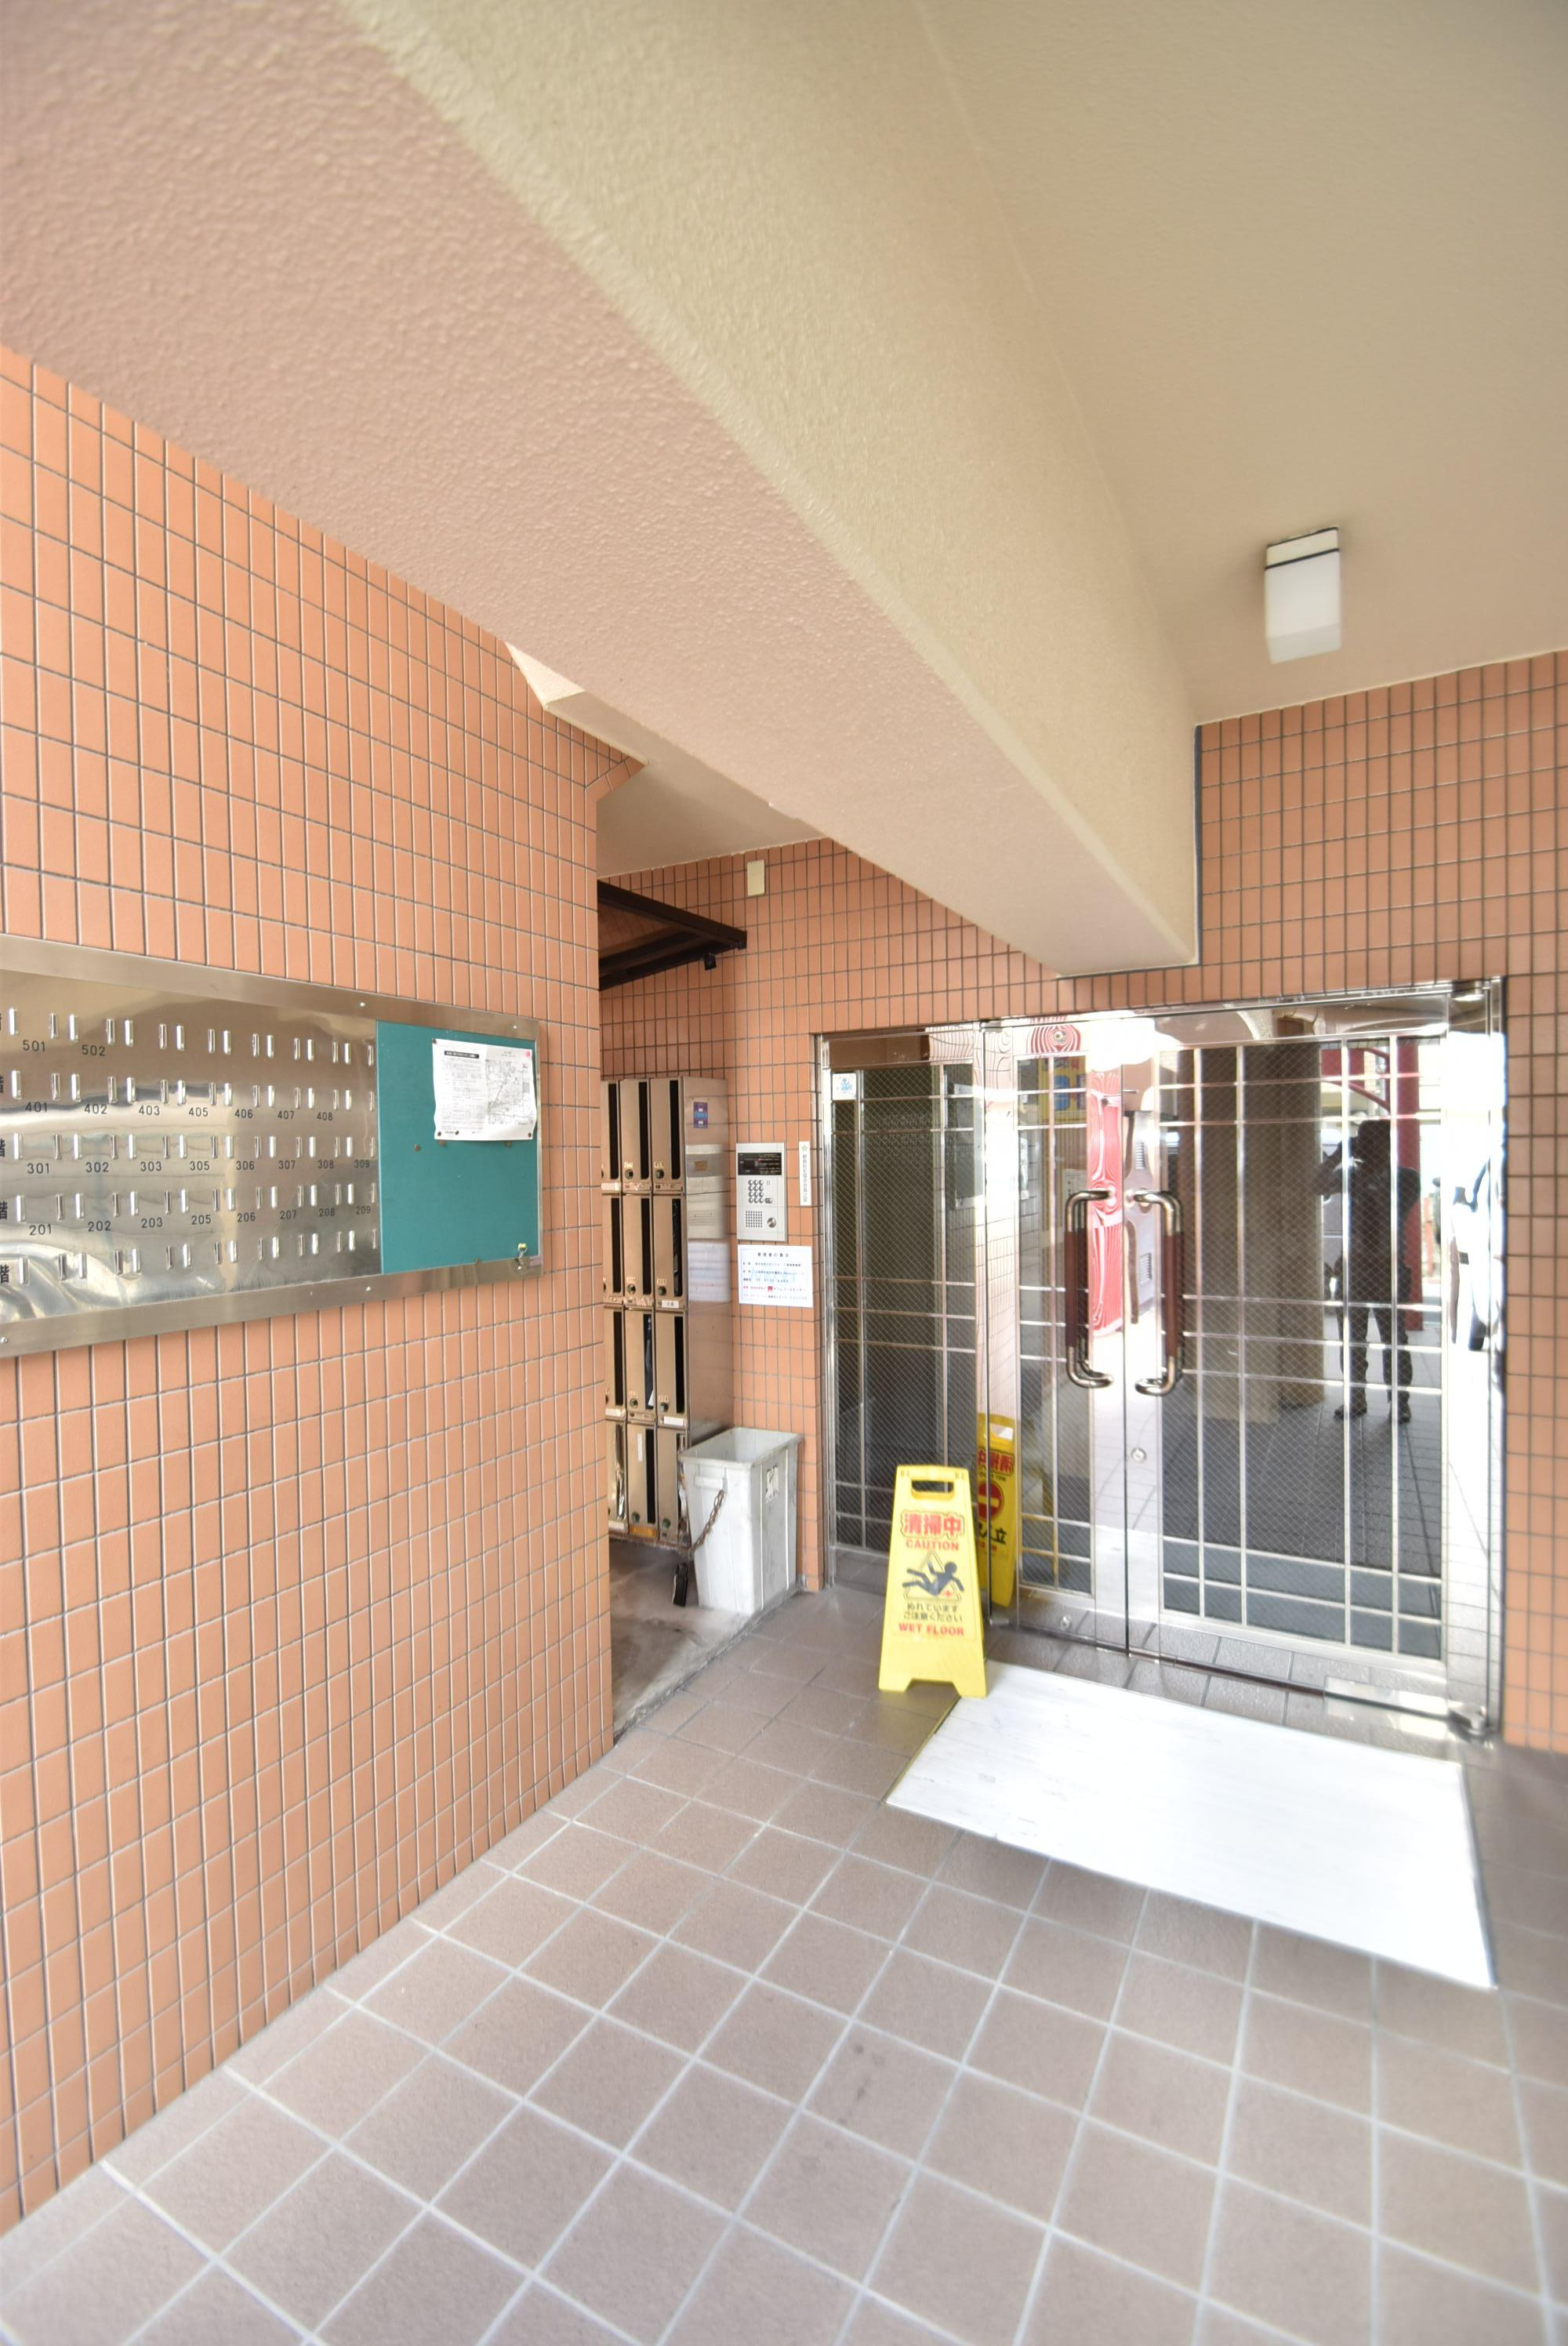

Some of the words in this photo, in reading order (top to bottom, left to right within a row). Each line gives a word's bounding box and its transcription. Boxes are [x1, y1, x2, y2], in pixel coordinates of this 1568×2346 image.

[23, 1040, 46, 1052] 501
[82, 1044, 105, 1057] 502
[25, 1102, 49, 1113] 401
[85, 1102, 107, 1115] 402
[139, 1106, 160, 1117] 403
[189, 1107, 208, 1117] 405
[234, 1109, 253, 1120] 406
[278, 1110, 294, 1120] 407
[317, 1112, 332, 1121] 408
[27, 1163, 50, 1175] 301
[85, 1162, 109, 1174] 302
[140, 1161, 162, 1172] 303
[190, 1161, 209, 1171] 305
[237, 1160, 254, 1171] 306
[279, 1160, 295, 1170] 307
[318, 1160, 333, 1169] 308
[354, 1160, 369, 1168] 309
[29, 1224, 52, 1237] 201
[88, 1221, 111, 1233] 202
[141, 1217, 162, 1229] 203
[191, 1215, 211, 1226] 205
[238, 1212, 256, 1223] 206
[280, 1210, 296, 1220] 207
[319, 1208, 335, 1218] 208
[356, 1206, 372, 1215] 209
[904, 1513, 961, 1536] 清掃中
[906, 1539, 959, 1551] CAUTION
[907, 1603, 959, 1612] ぬれています
[898, 1622, 923, 1632] WET
[927, 1625, 964, 1636] FLOOR
